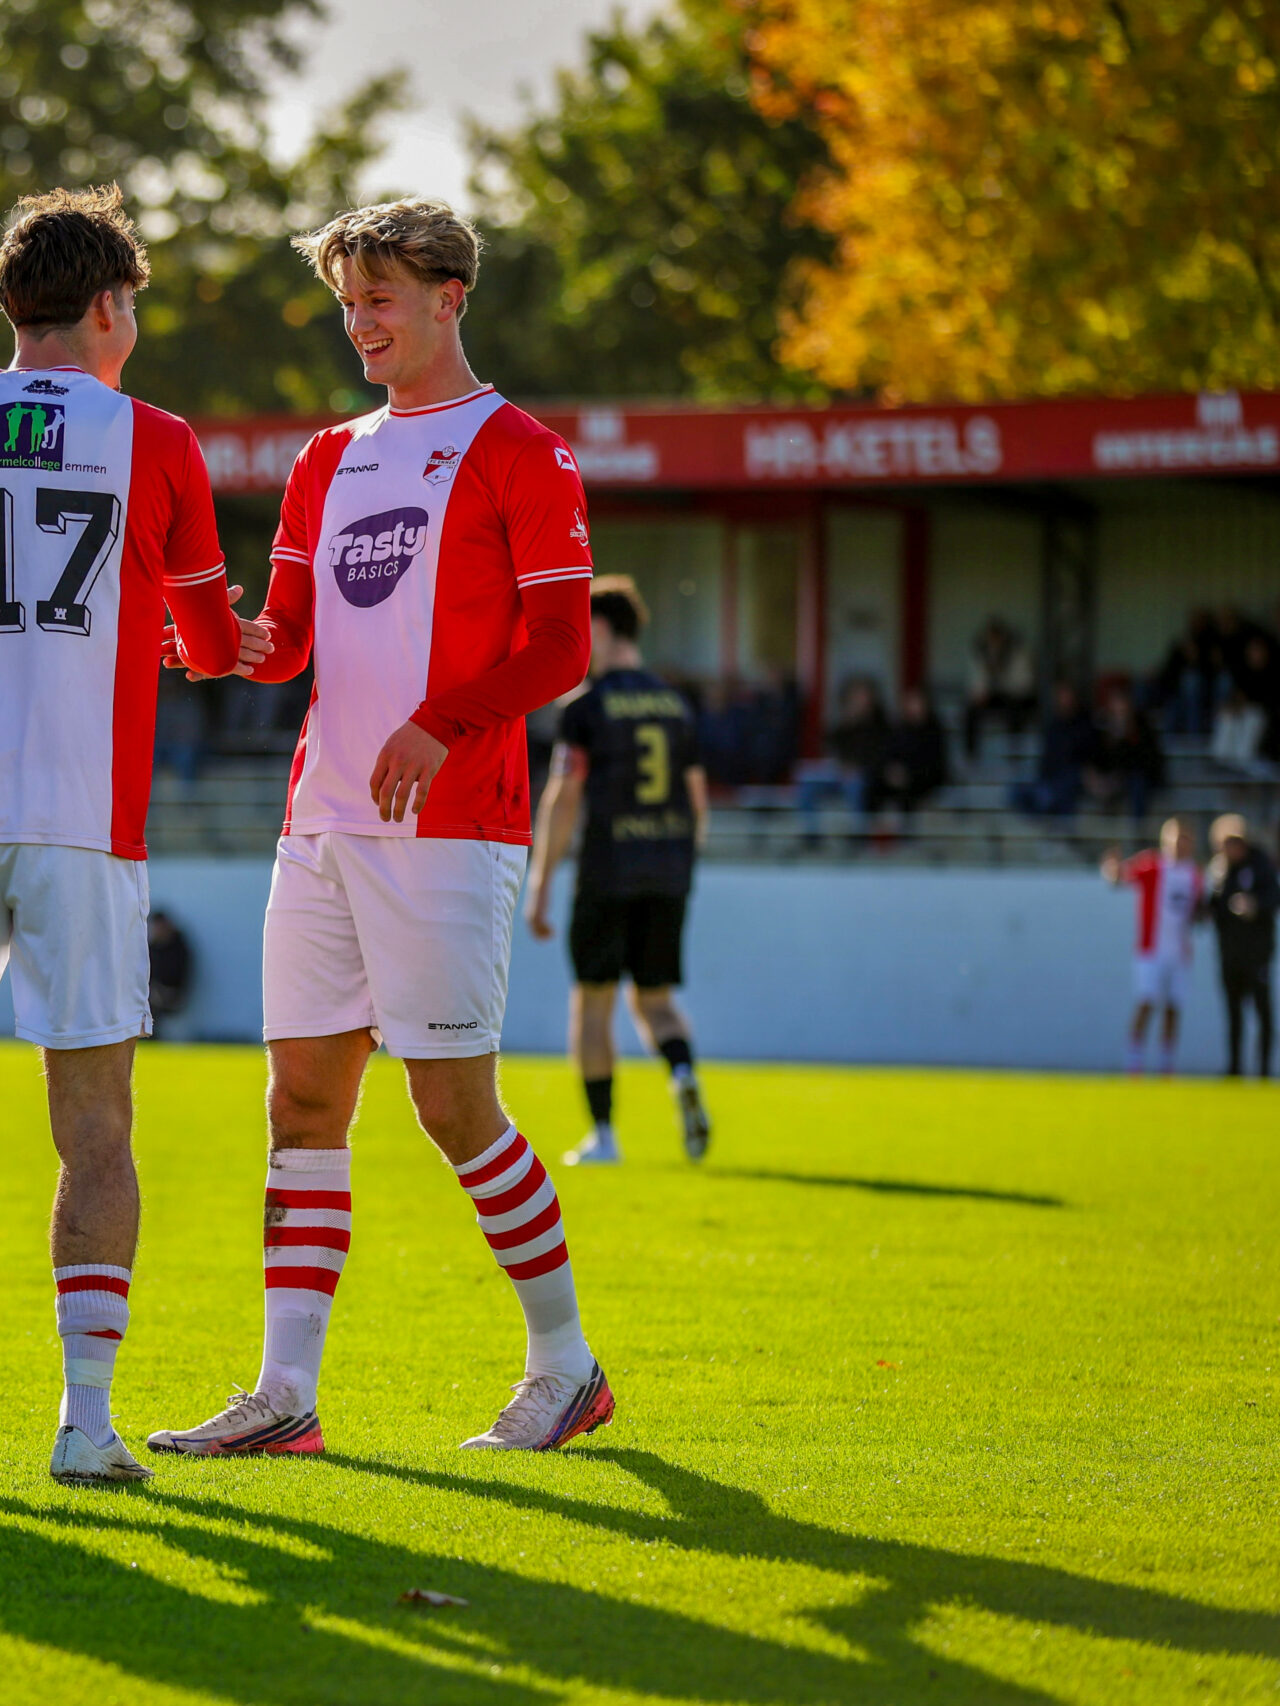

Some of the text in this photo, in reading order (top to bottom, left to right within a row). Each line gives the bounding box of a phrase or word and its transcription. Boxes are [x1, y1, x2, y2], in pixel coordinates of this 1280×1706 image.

[64, 462, 107, 474] emmen
[336, 463, 380, 476] STANNO
[328, 521, 427, 568] Tasty
[347, 560, 399, 582] BASICS
[634, 722, 670, 804] 3
[427, 1021, 478, 1030] STANNO
